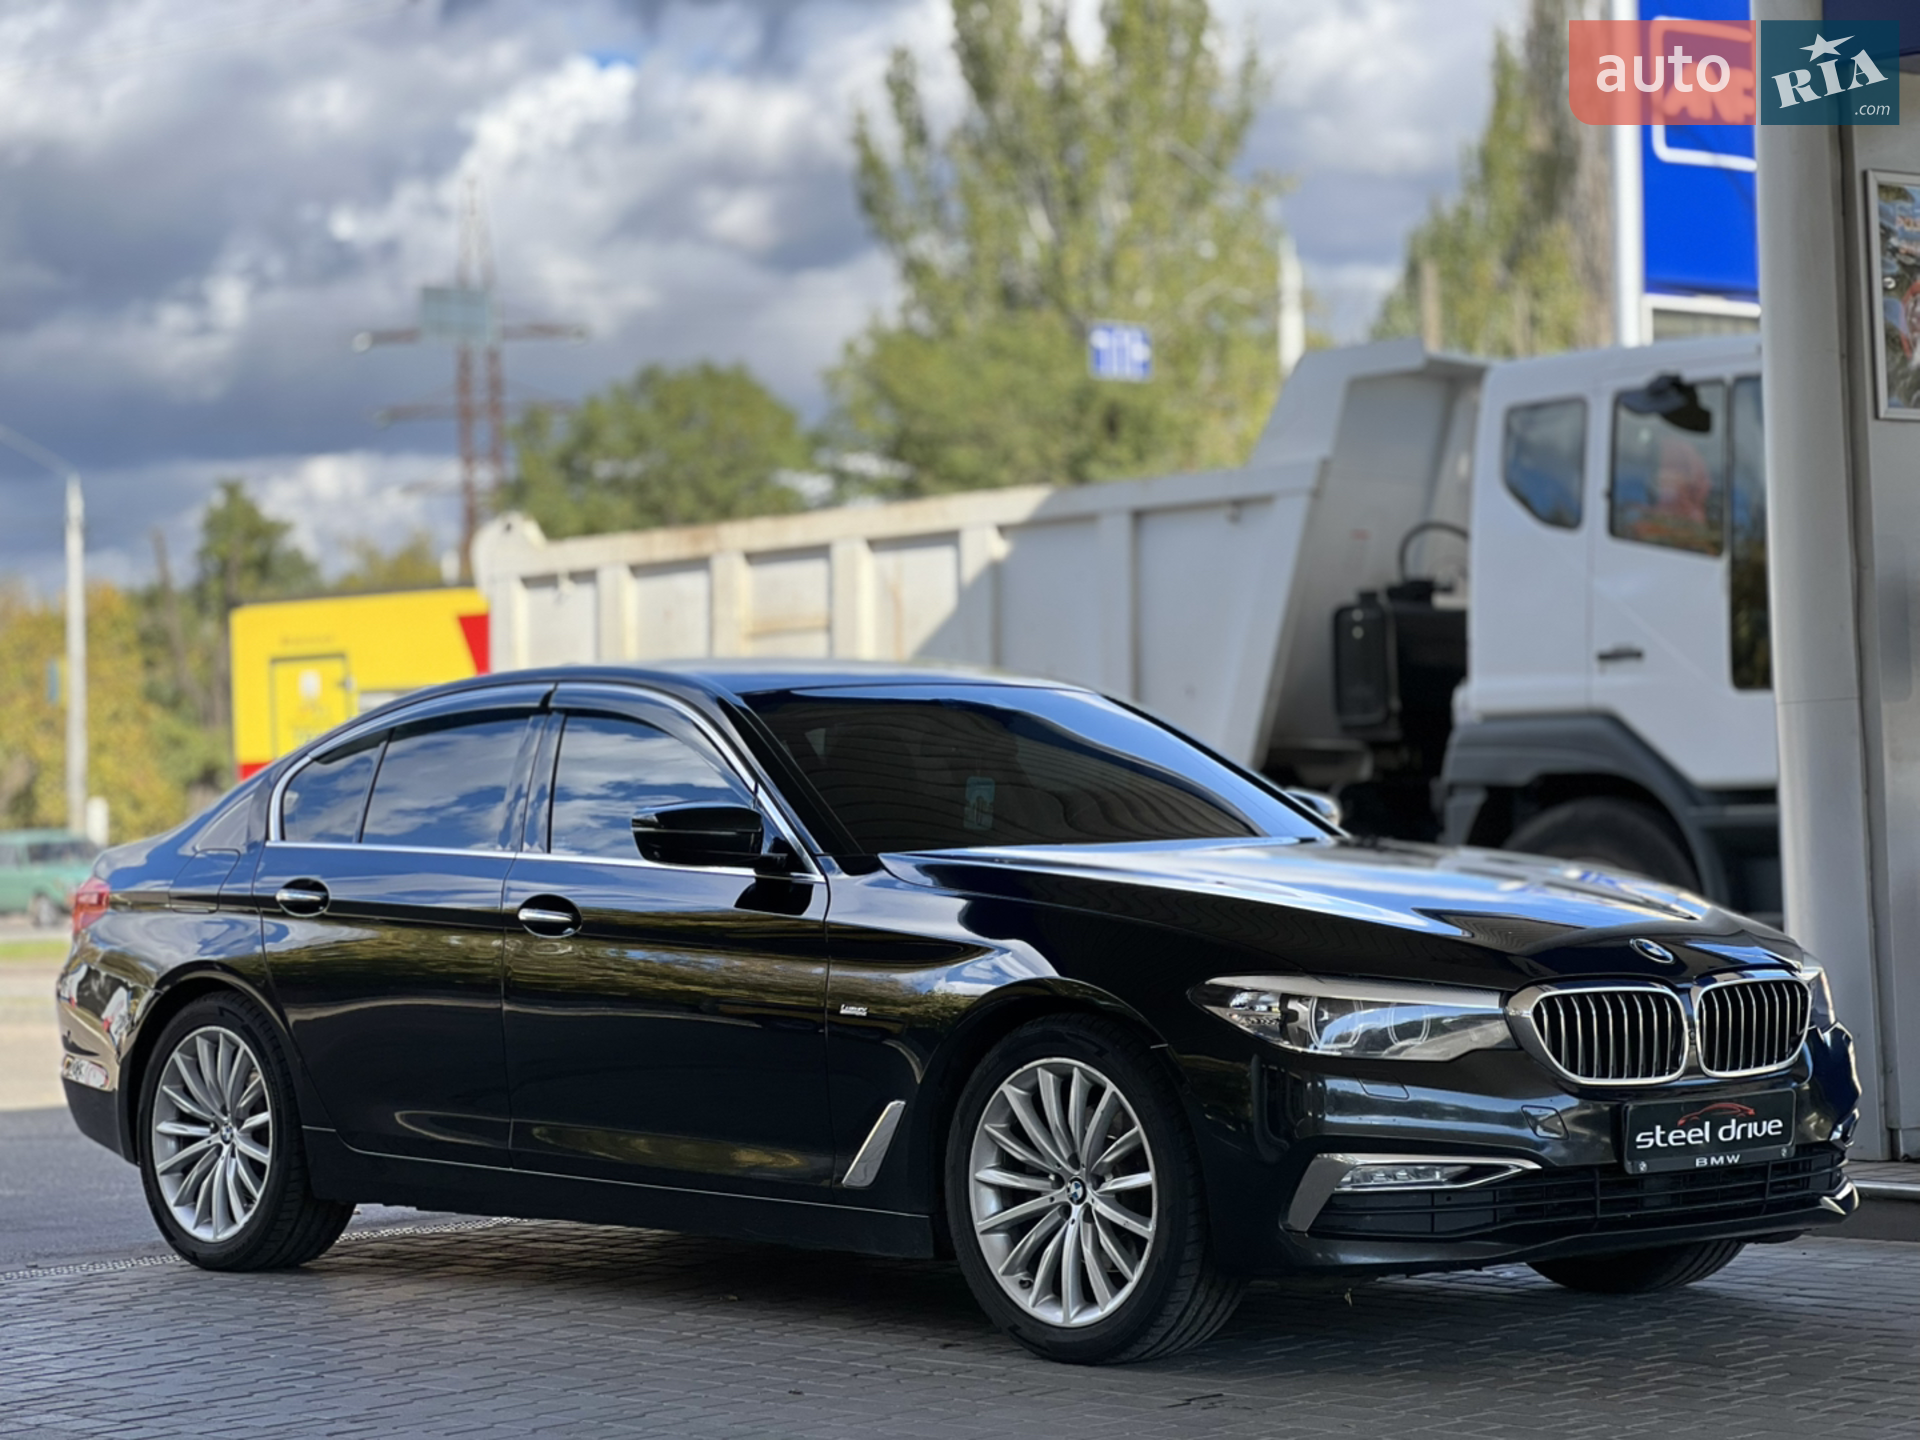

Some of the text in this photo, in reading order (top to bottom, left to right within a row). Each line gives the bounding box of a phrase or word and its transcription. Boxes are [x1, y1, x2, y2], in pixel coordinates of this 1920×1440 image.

[1635, 1118, 1783, 1149] steel drive
[1695, 1154, 1741, 1167] BMW
